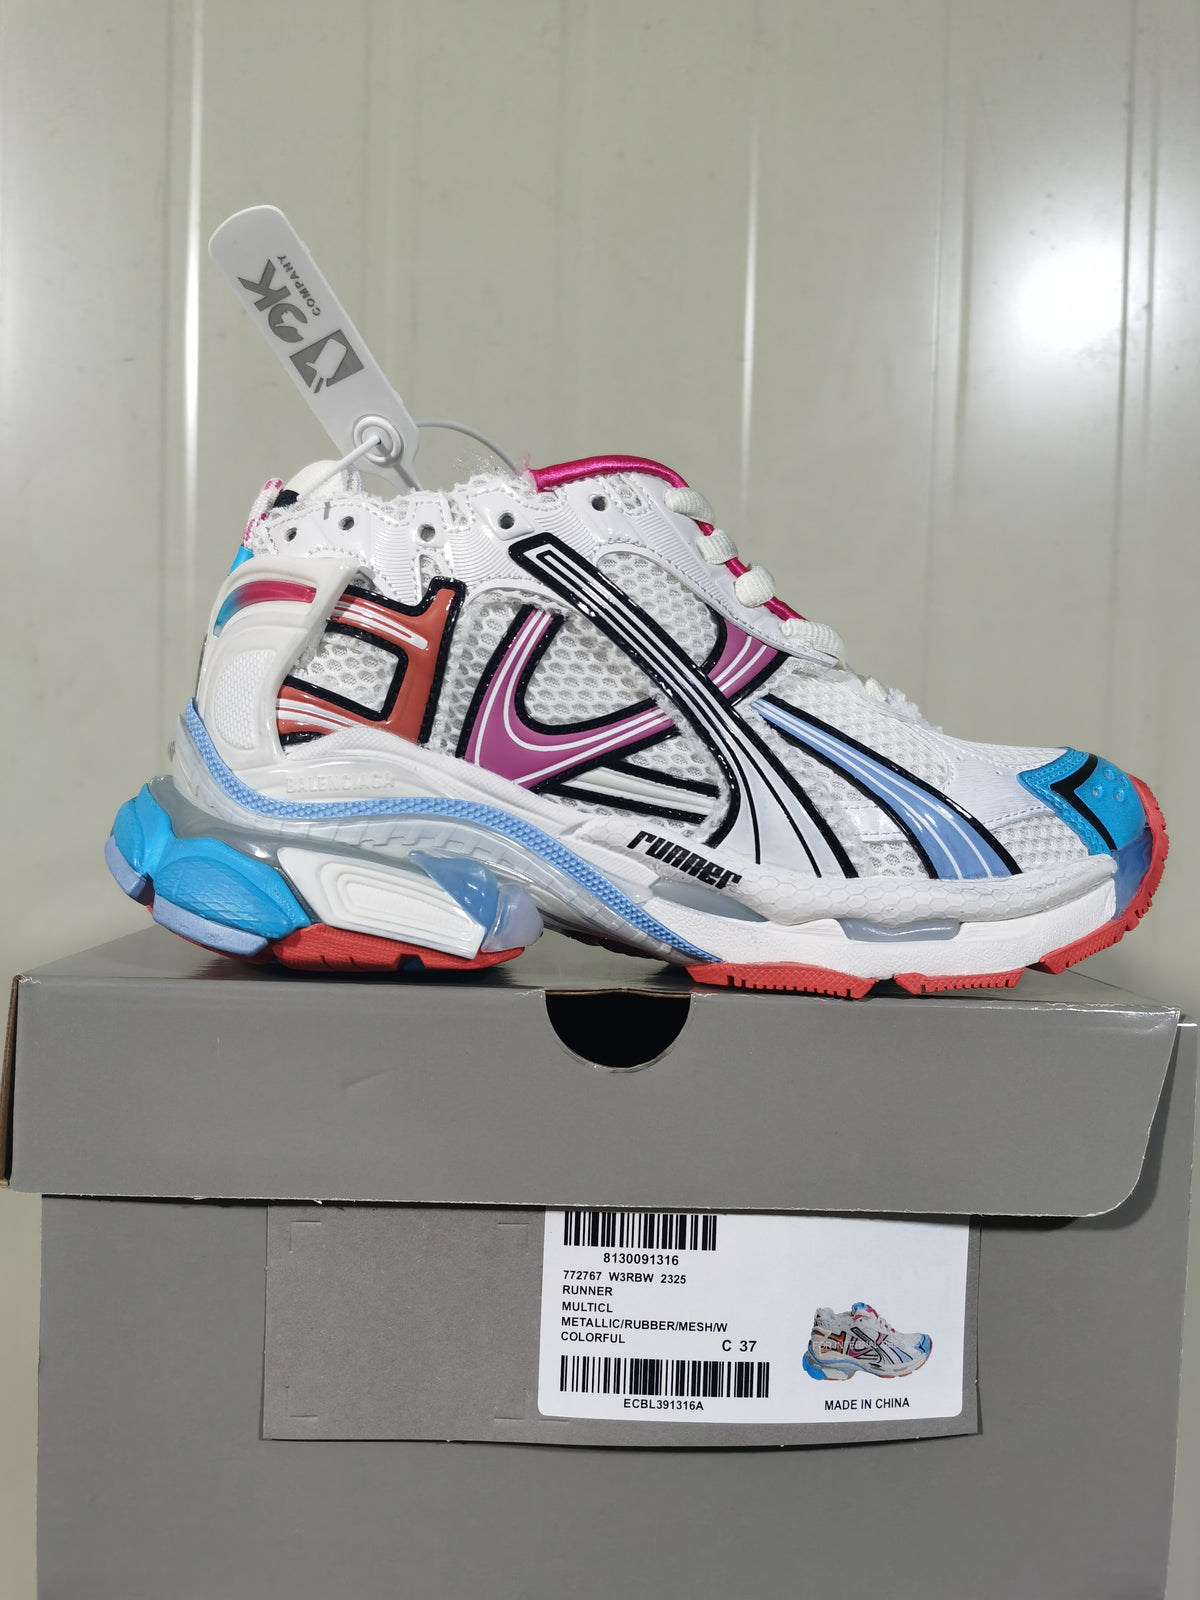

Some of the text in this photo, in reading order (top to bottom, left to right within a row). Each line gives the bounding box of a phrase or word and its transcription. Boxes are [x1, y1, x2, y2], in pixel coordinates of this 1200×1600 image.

[276, 255, 321, 316] COMPANY
[286, 772, 396, 793] BALENCIAGA
[603, 1252, 679, 1266] 8130091316
[563, 1270, 687, 1284] 772767 W3RBW 2325
[562, 1285, 613, 1297] RUNNER
[561, 1301, 613, 1313] MULTICL
[561, 1316, 728, 1333] METALLIC/RUBBER/MESH/W
[560, 1331, 626, 1344] COLORFUL
[721, 1339, 757, 1352] C 37
[623, 1398, 704, 1411] ECBL391316A
[824, 1396, 910, 1411] MADE IN CHINA
